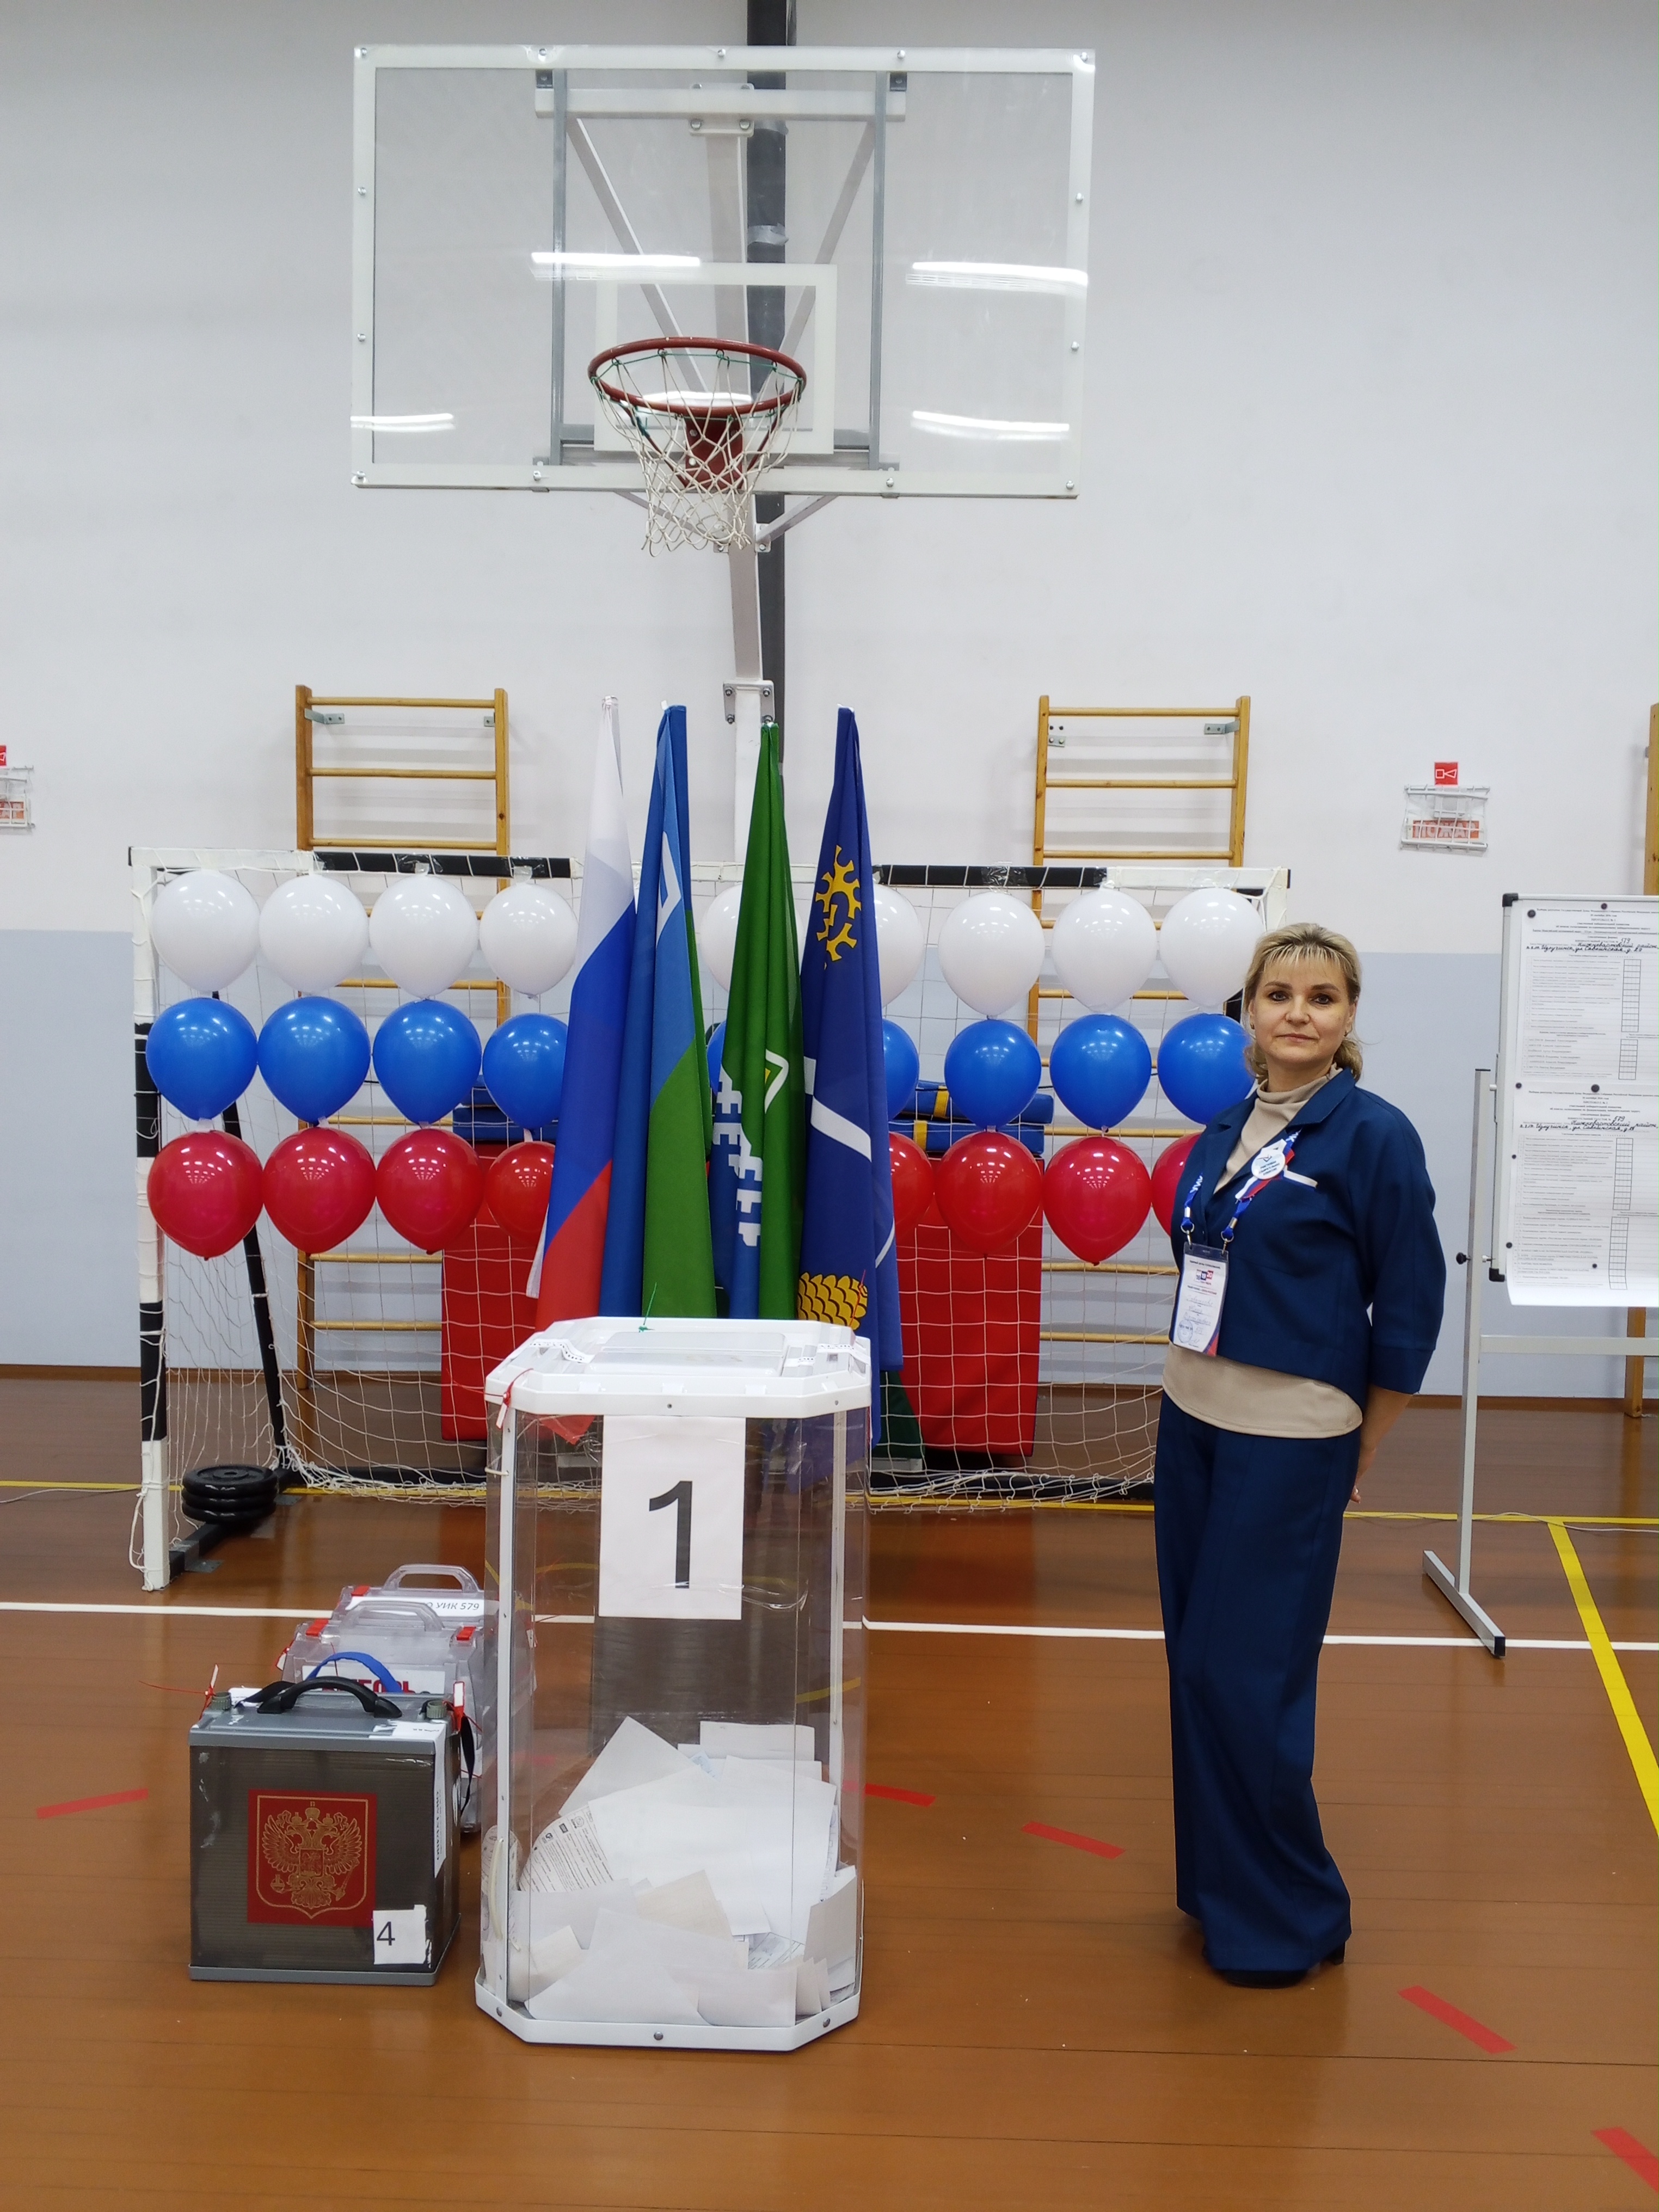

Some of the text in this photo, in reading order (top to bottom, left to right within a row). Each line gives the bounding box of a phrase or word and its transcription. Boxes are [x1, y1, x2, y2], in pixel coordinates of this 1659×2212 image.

[1415, 821, 1476, 838] ПОЖАР
[649, 1480, 693, 1589] 1
[460, 1602, 480, 1611] 579
[377, 1921, 395, 1946] 4
